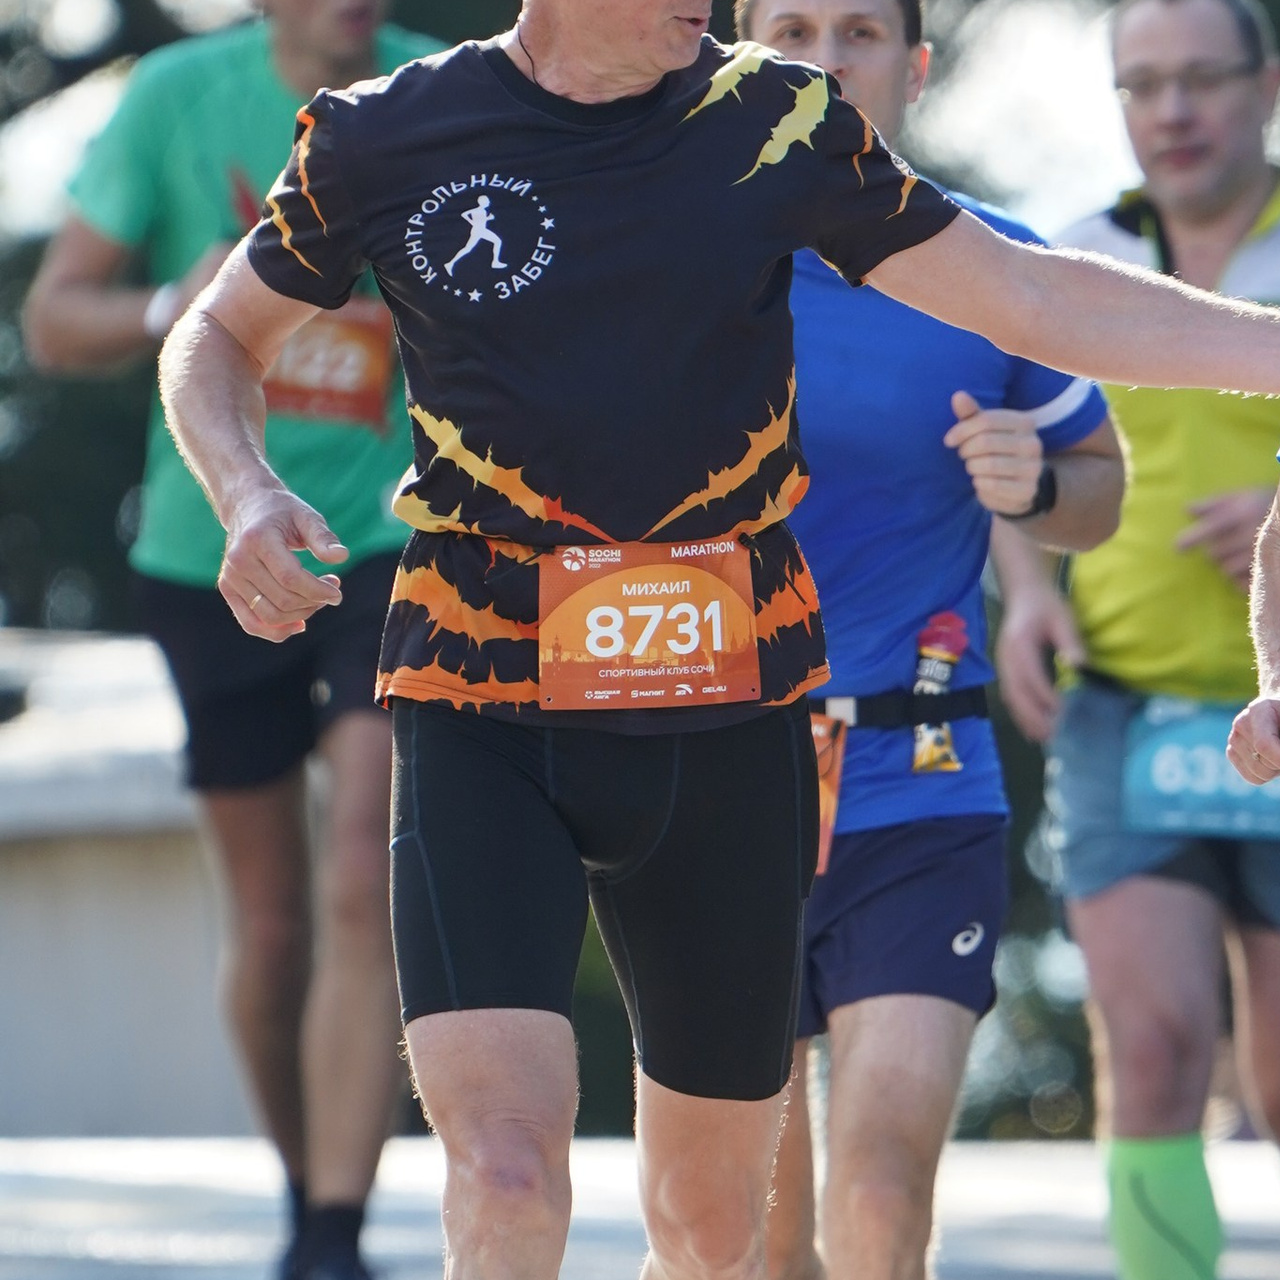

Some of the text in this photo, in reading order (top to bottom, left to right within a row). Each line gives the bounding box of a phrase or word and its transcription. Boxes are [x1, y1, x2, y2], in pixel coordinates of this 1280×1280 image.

[404, 173, 533, 285] КОНТРОЛЬНЫЙ
[493, 236, 557, 300] ЗАБЕГ
[588, 549, 621, 558] SOCHI
[671, 541, 735, 558] MARATHON
[622, 580, 691, 596] МИХАИЛ
[584, 600, 723, 658] 8731
[598, 664, 715, 677] СПОРТИВНЫЙ КЛУБ СОЧИ
